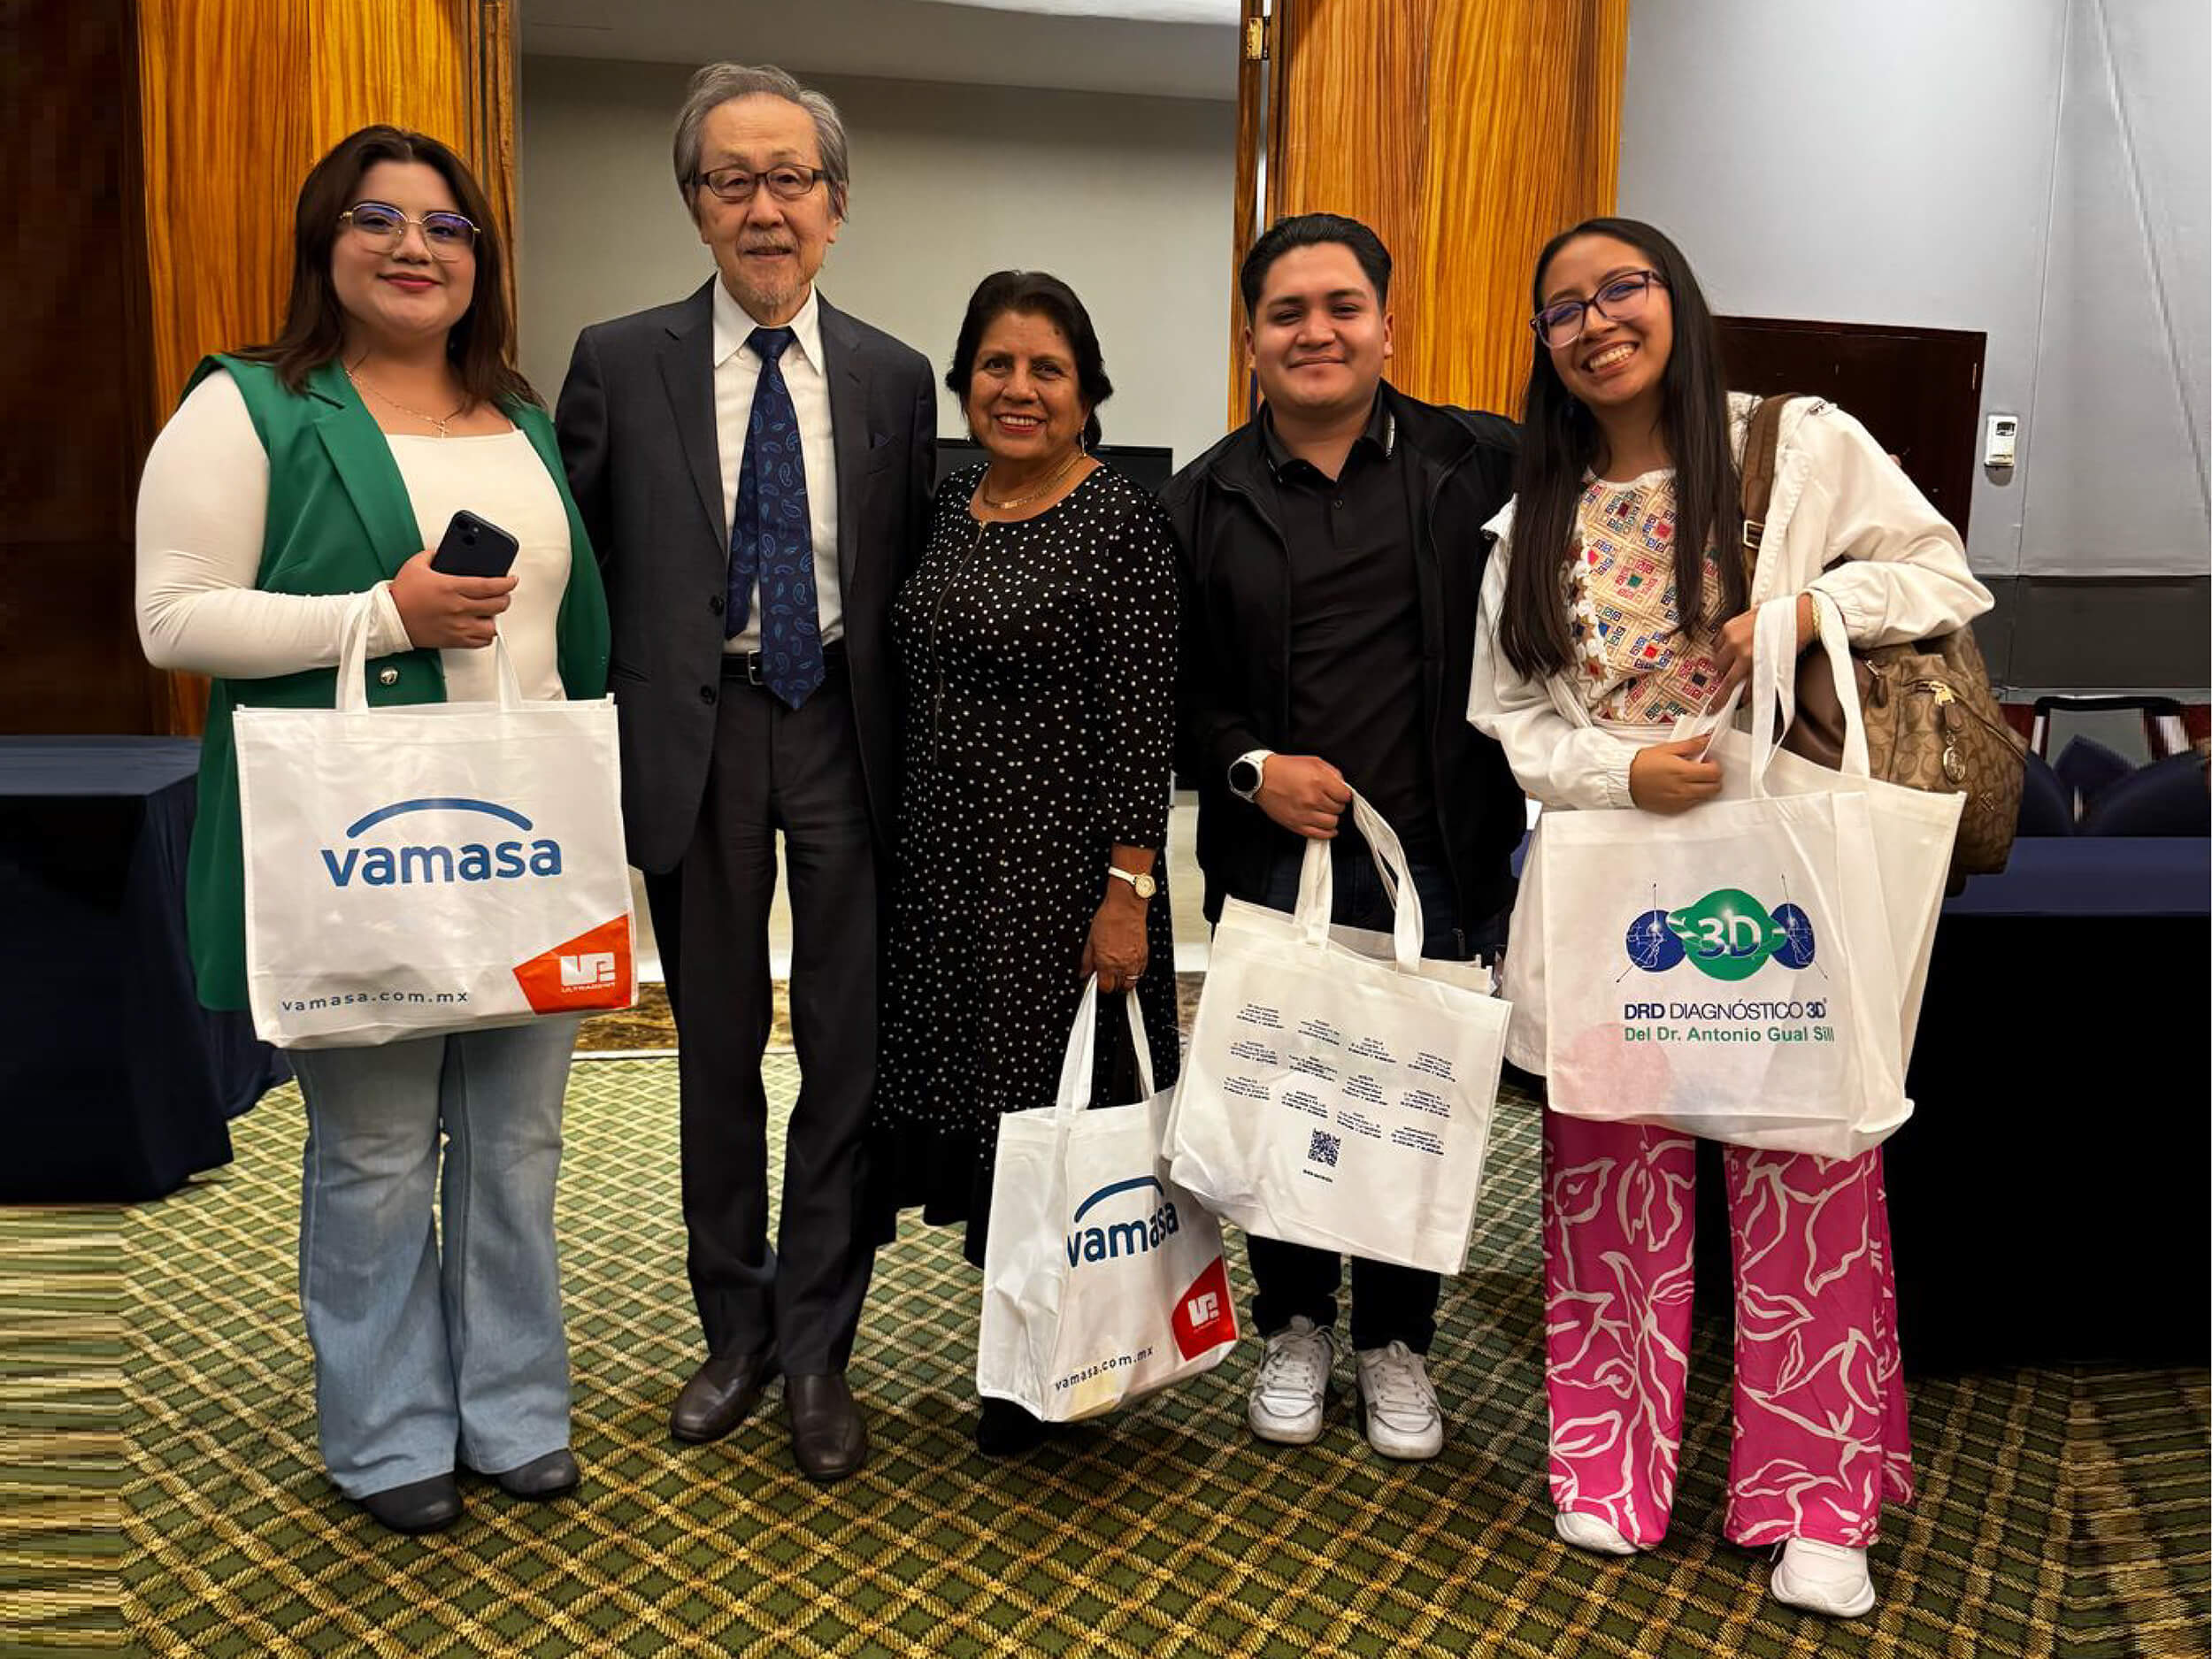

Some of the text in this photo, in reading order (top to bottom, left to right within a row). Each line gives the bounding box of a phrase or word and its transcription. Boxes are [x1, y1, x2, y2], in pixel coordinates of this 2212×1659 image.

[321, 840, 562, 887] vamasa
[1697, 914, 1761, 958] 3D
[282, 991, 468, 1011] vamasa.com.mx
[1624, 1003, 1665, 1019] DRD
[1670, 998, 1803, 1019] DIAGNÓSTICO
[1624, 1026, 1650, 1042] Del
[1656, 1027, 1681, 1041] Dr.
[1686, 1026, 1761, 1042] Antonio
[1767, 1025, 1809, 1042] Gual
[1067, 1202, 1179, 1268] vamasa
[1056, 1346, 1153, 1392] vamasa.com.mx
